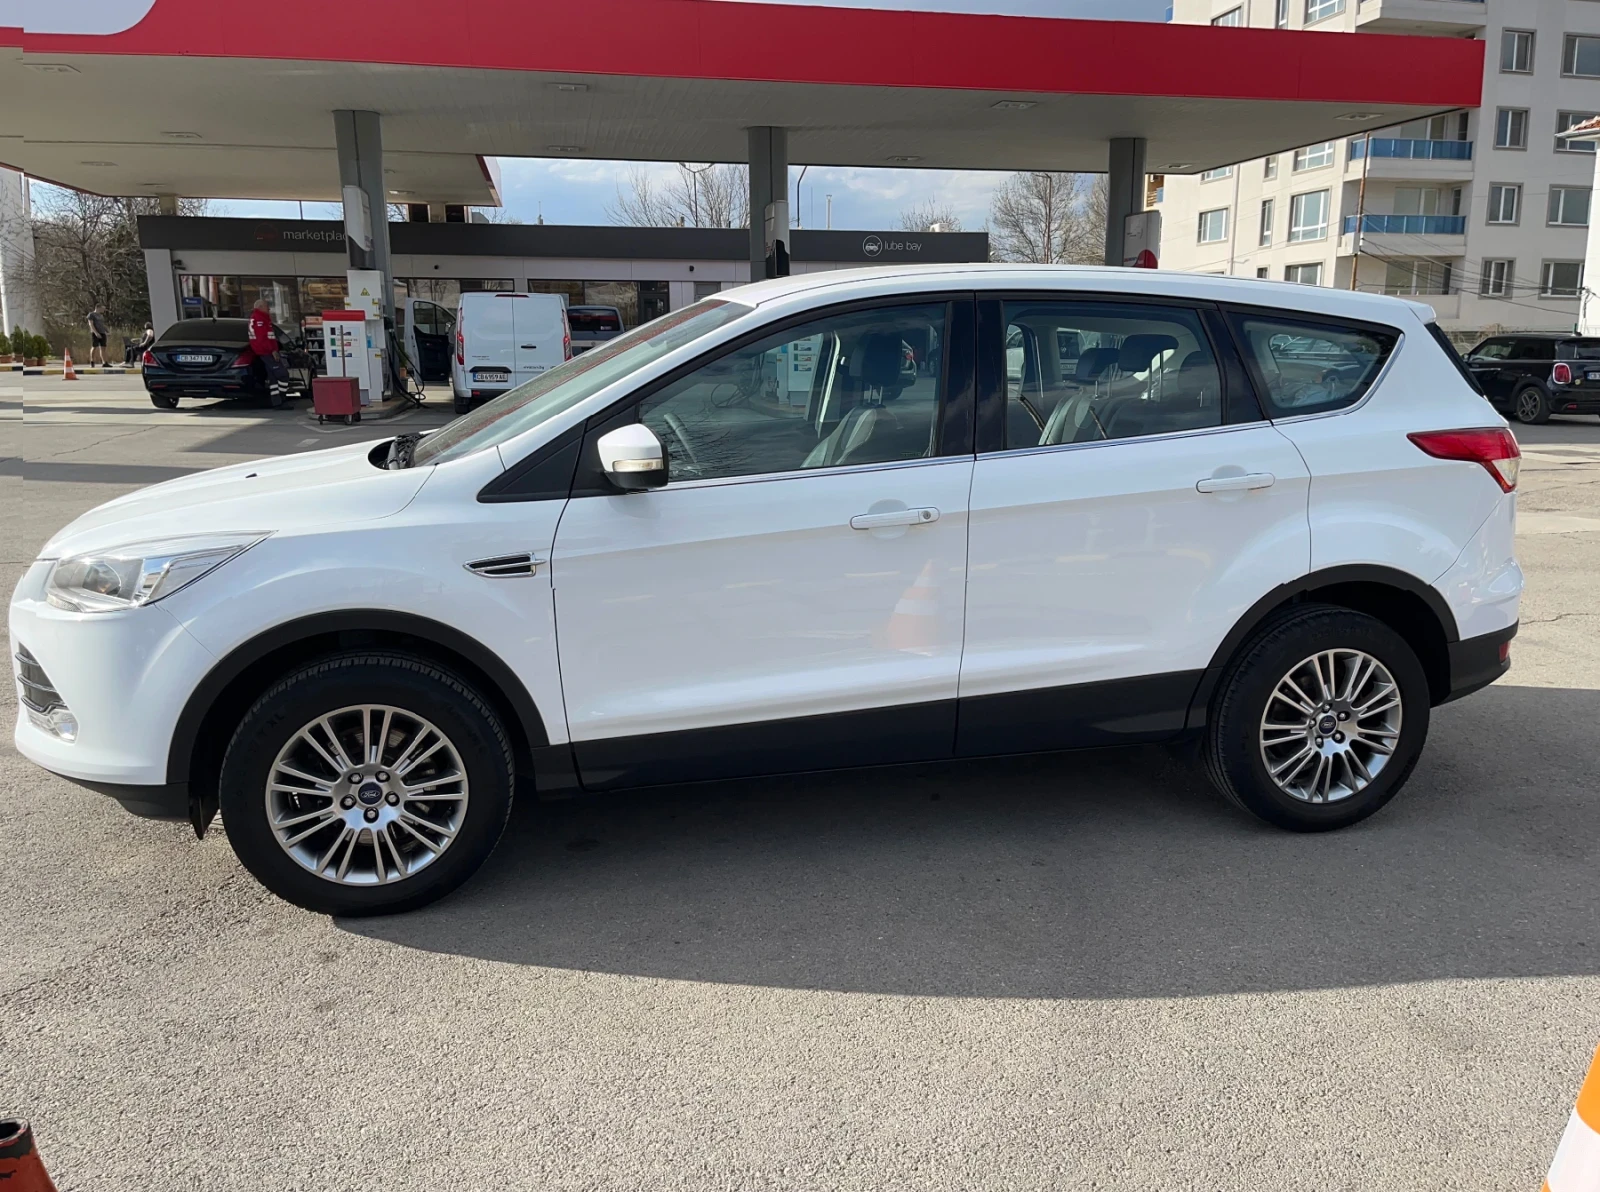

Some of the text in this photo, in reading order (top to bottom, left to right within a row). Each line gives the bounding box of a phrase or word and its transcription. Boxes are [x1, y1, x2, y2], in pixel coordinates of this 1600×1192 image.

[283, 230, 346, 242] marketplac
[884, 240, 922, 252] lube bay
